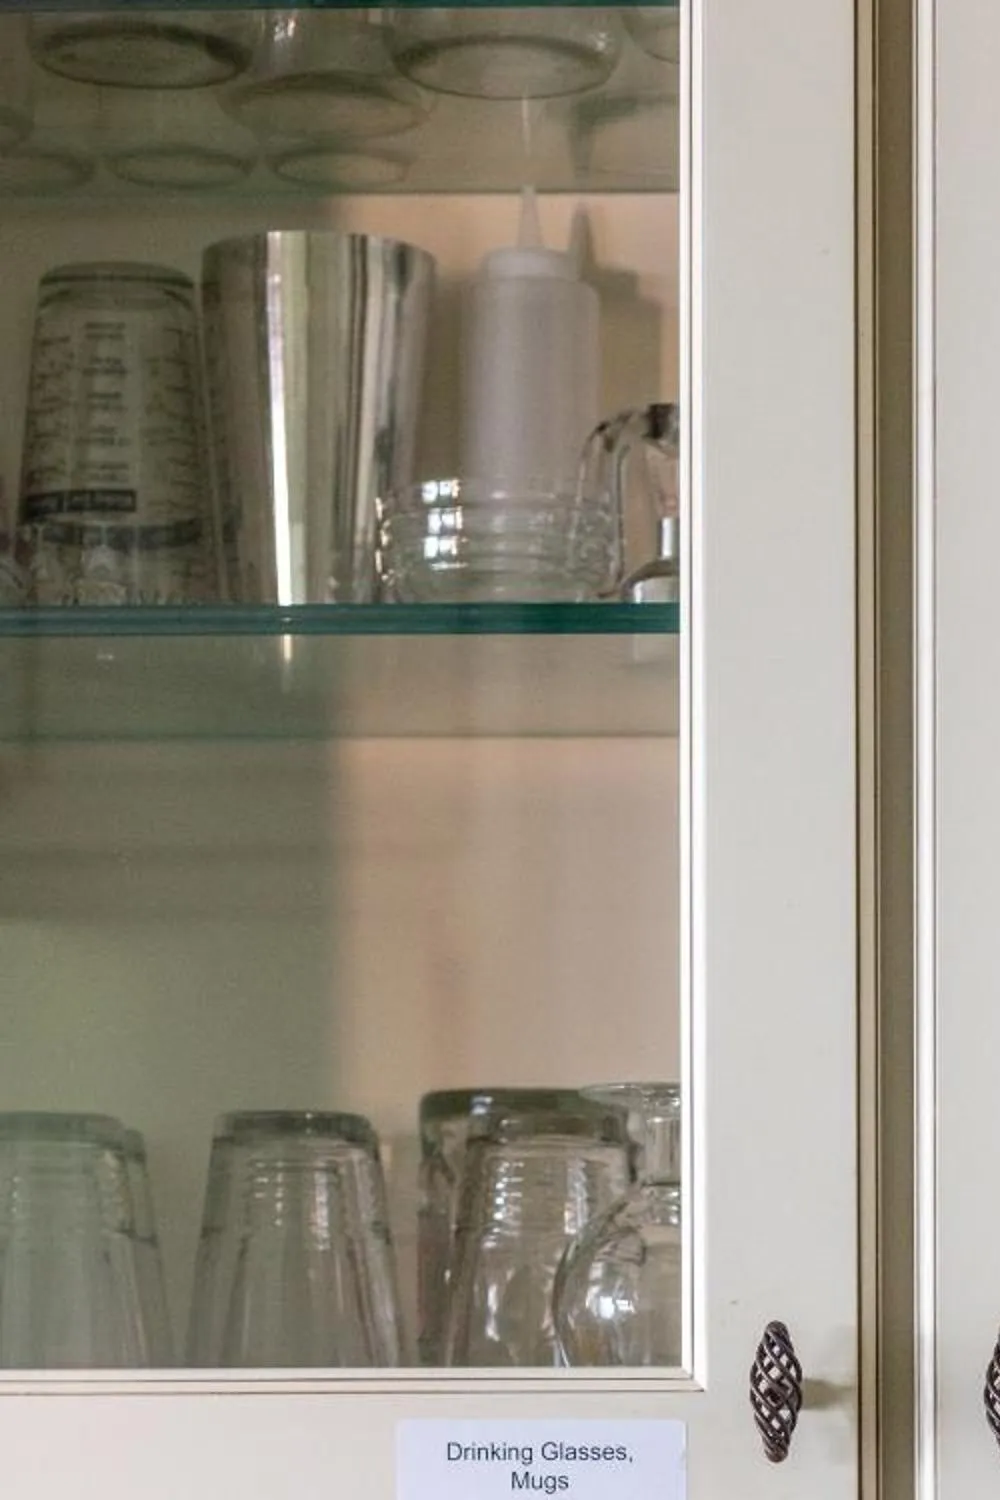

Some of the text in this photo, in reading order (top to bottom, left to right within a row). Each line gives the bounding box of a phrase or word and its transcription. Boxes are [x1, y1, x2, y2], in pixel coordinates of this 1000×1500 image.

[447, 1442, 633, 1466] Drinking Glasses,
[511, 1471, 569, 1495] Mugs
